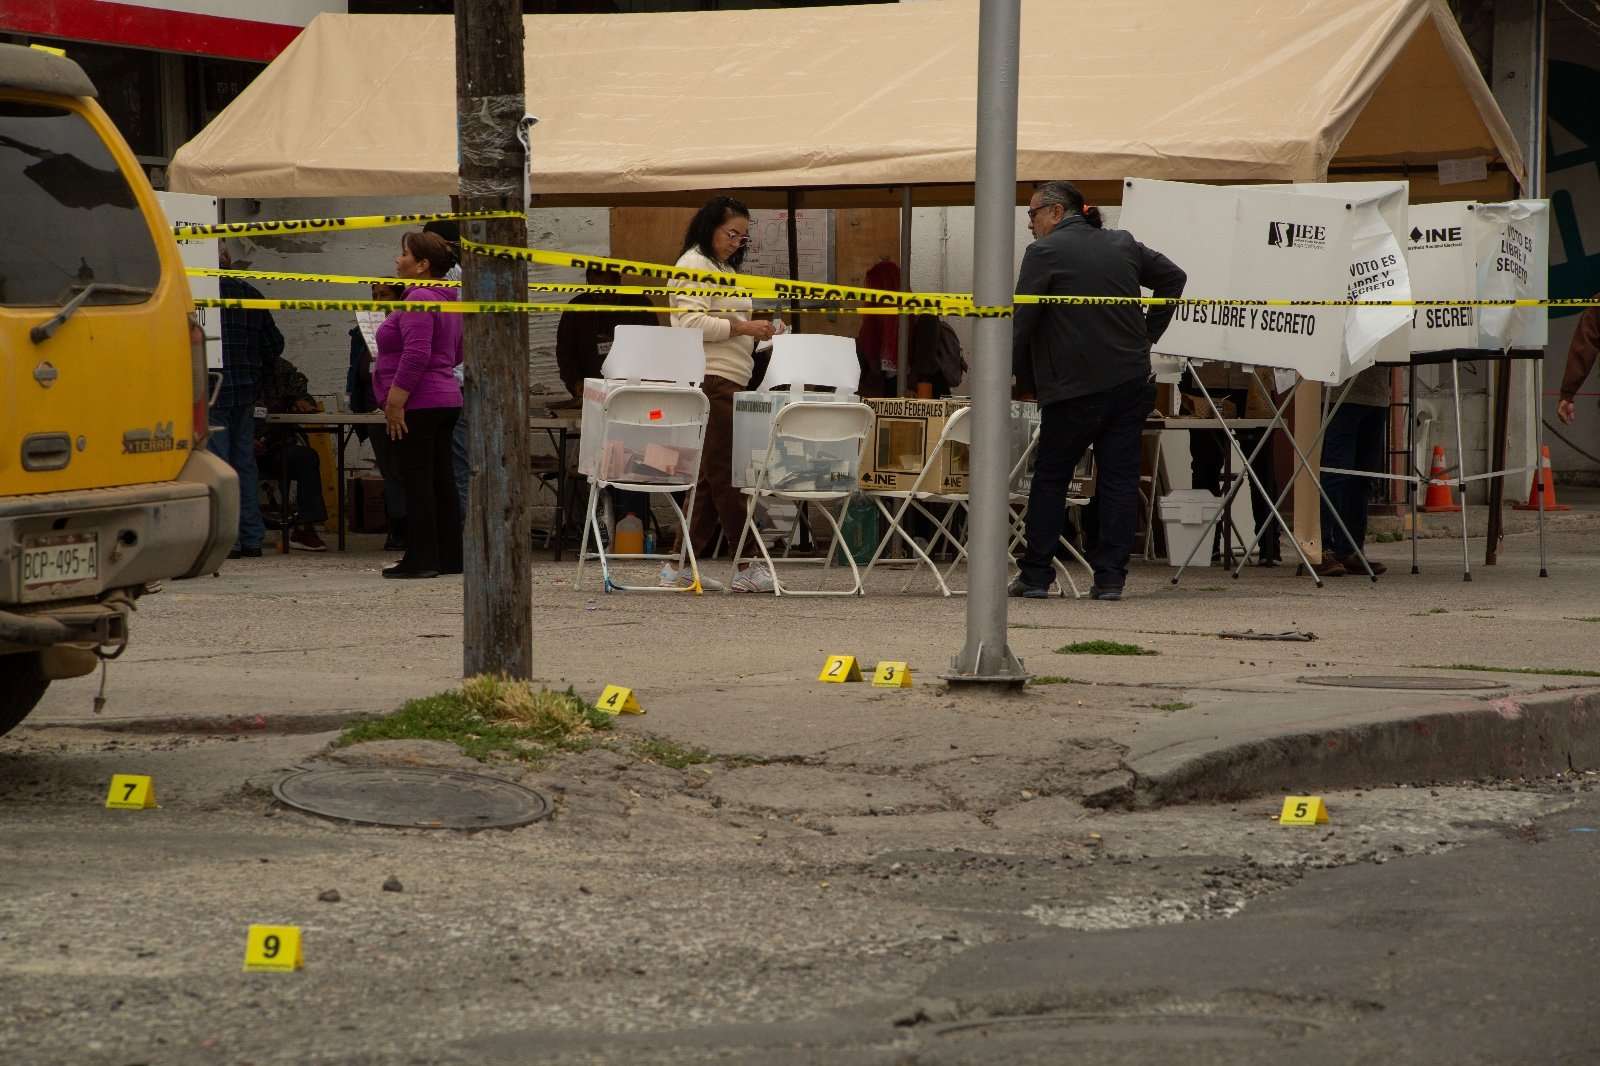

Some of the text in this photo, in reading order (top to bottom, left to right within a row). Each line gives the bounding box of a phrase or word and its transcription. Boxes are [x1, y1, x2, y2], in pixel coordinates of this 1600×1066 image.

[1296, 224, 1326, 241] IEE
[1426, 226, 1462, 243] INE
[1524, 236, 1532, 253] ES
[1349, 254, 1397, 277] VOTO ES
[1496, 257, 1528, 285] SECRETO
[1192, 303, 1207, 324] ES
[1210, 304, 1247, 328] LIBRE
[1250, 307, 1259, 330] Y
[1261, 309, 1316, 337] SECRETO
[904, 400, 943, 418] FEDERALES
[873, 474, 897, 486] INE
[950, 478, 962, 488] INE
[24, 547, 95, 580] BCP-495-A
[829, 661, 842, 675] 2
[883, 667, 895, 681] 3
[606, 692, 618, 706] 4
[123, 783, 136, 801] 7
[1294, 803, 1308, 818] 5
[263, 935, 280, 958] 9
